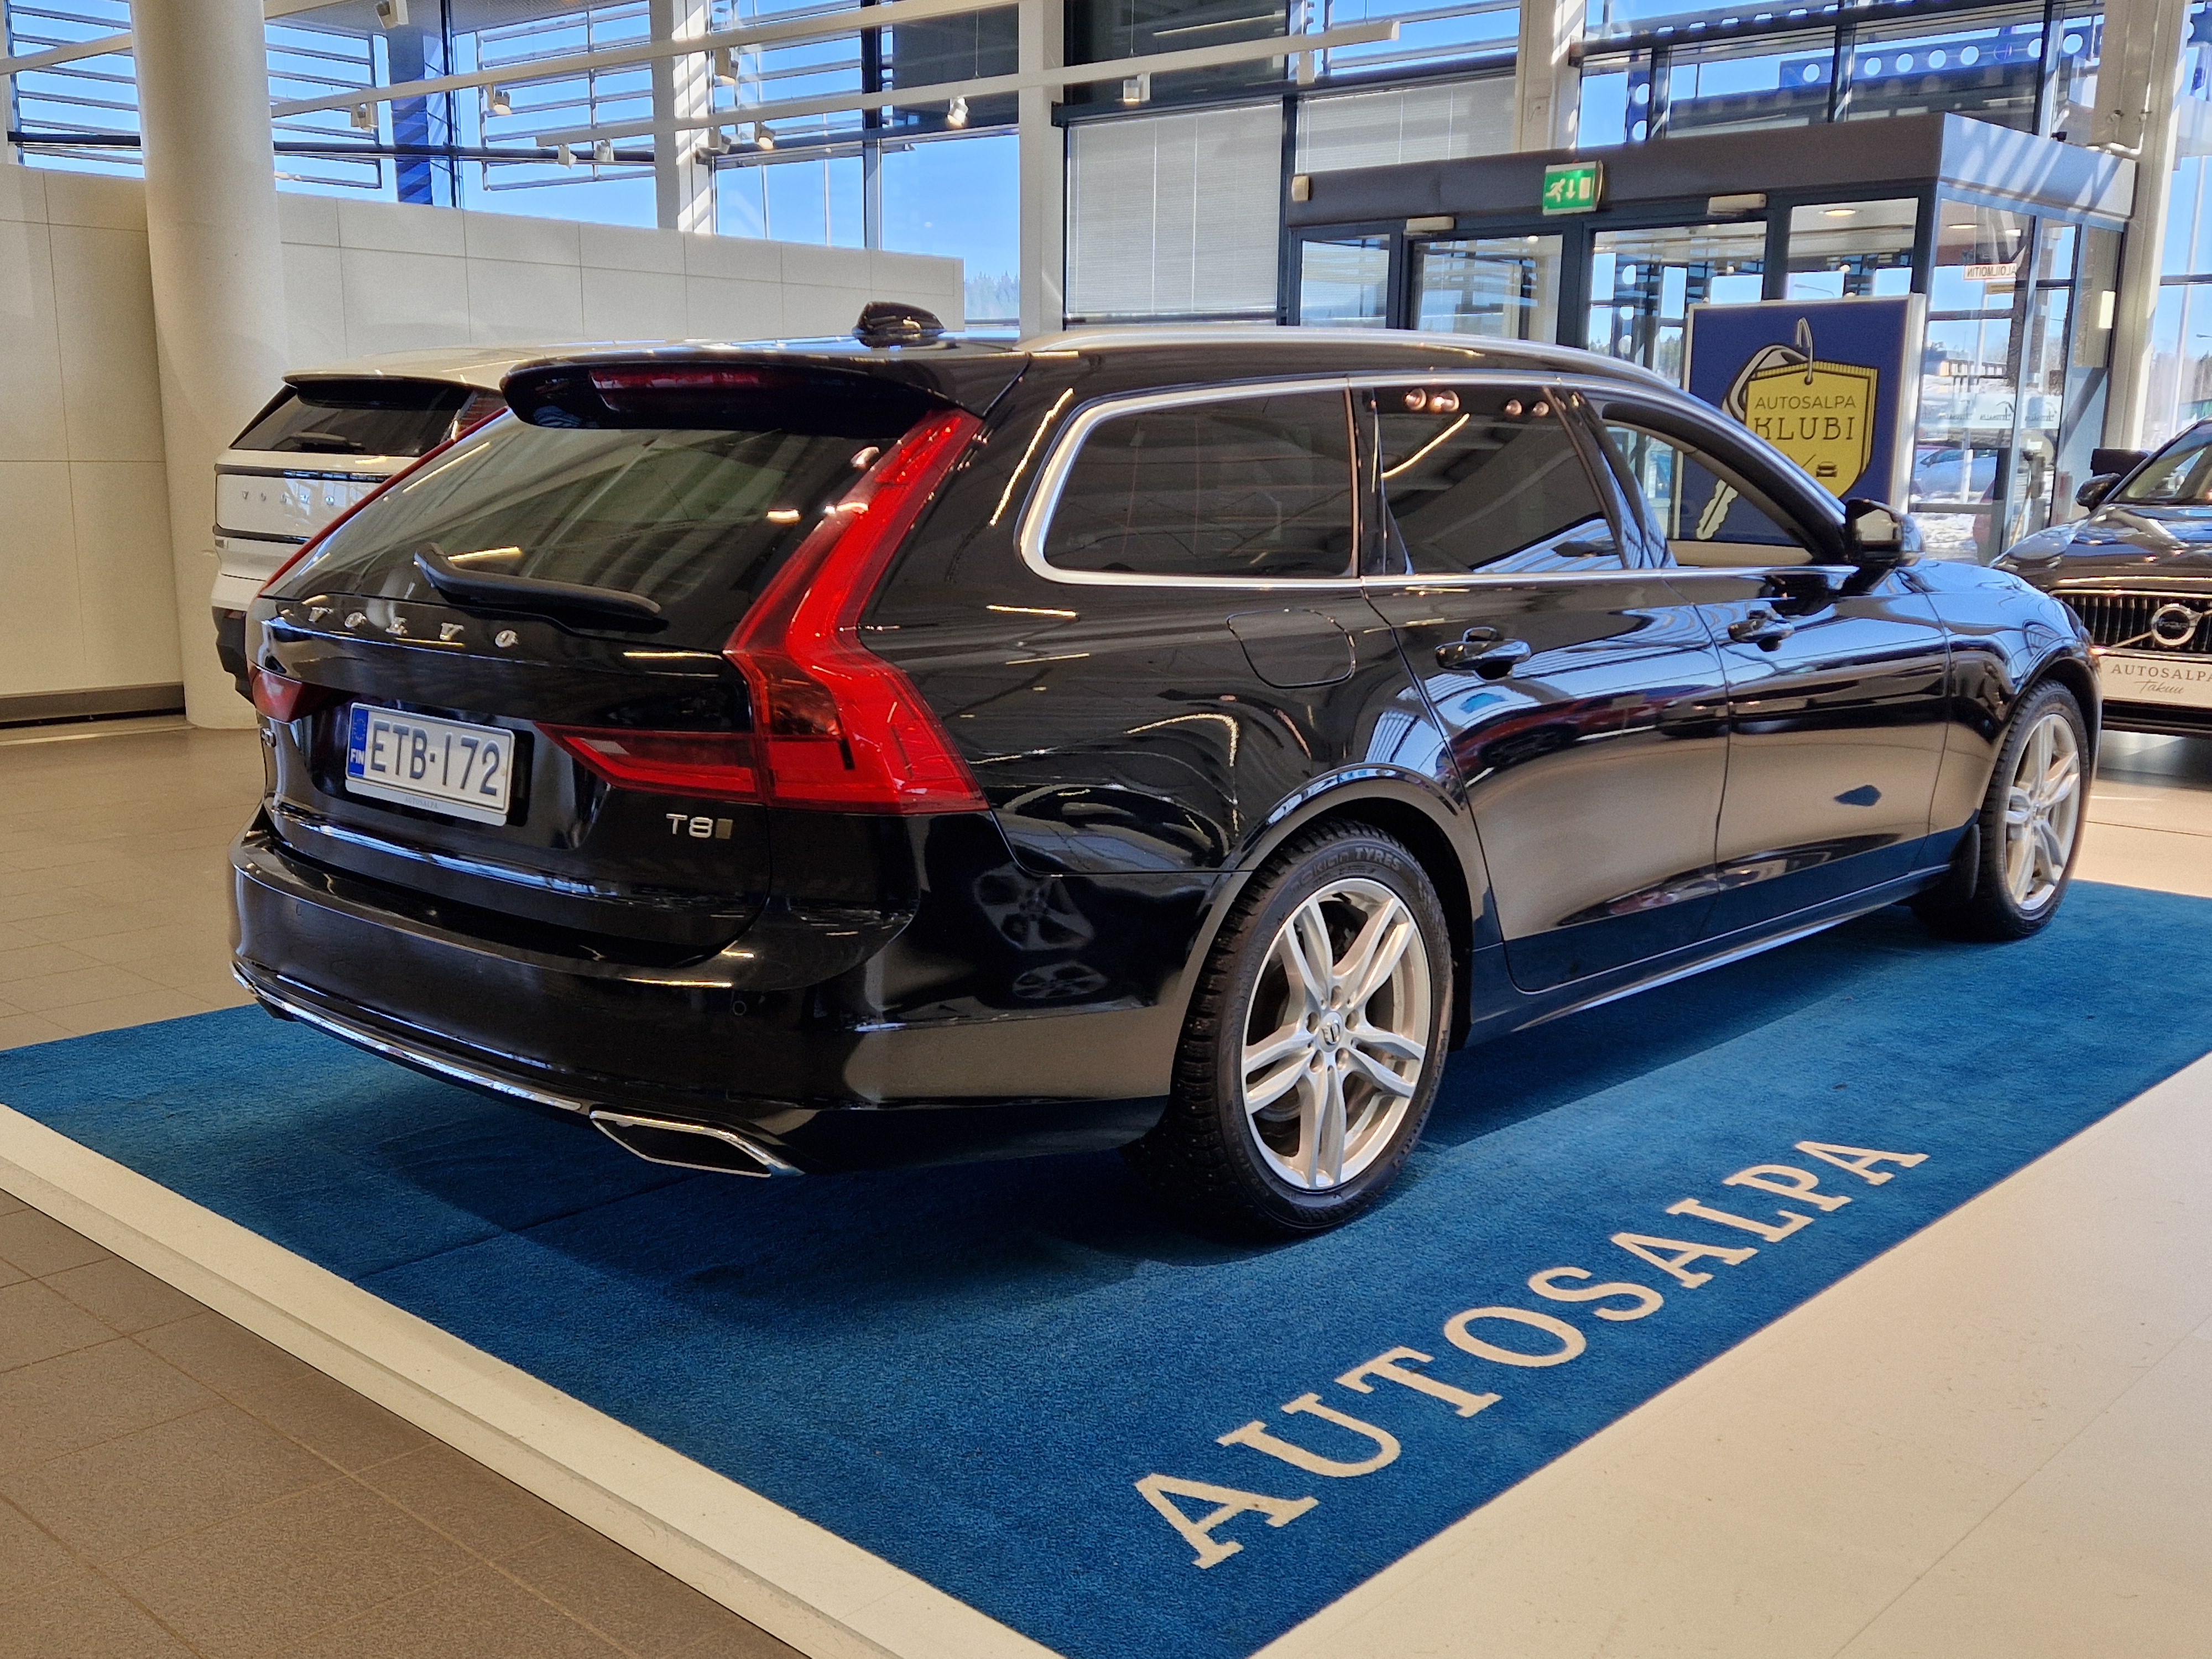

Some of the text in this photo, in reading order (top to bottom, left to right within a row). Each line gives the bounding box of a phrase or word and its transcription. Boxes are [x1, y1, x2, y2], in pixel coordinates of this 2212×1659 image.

[1755, 395, 1855, 410] AUTOSALPA
[1754, 416, 1855, 440] KLUBI
[2135, 679, 2184, 693] Takuu
[349, 719, 500, 796] FIN ETB-172
[666, 813, 713, 839] T8
[1355, 847, 1402, 872] TYRES
[1133, 1139, 1931, 1569] AUTOSALPA
